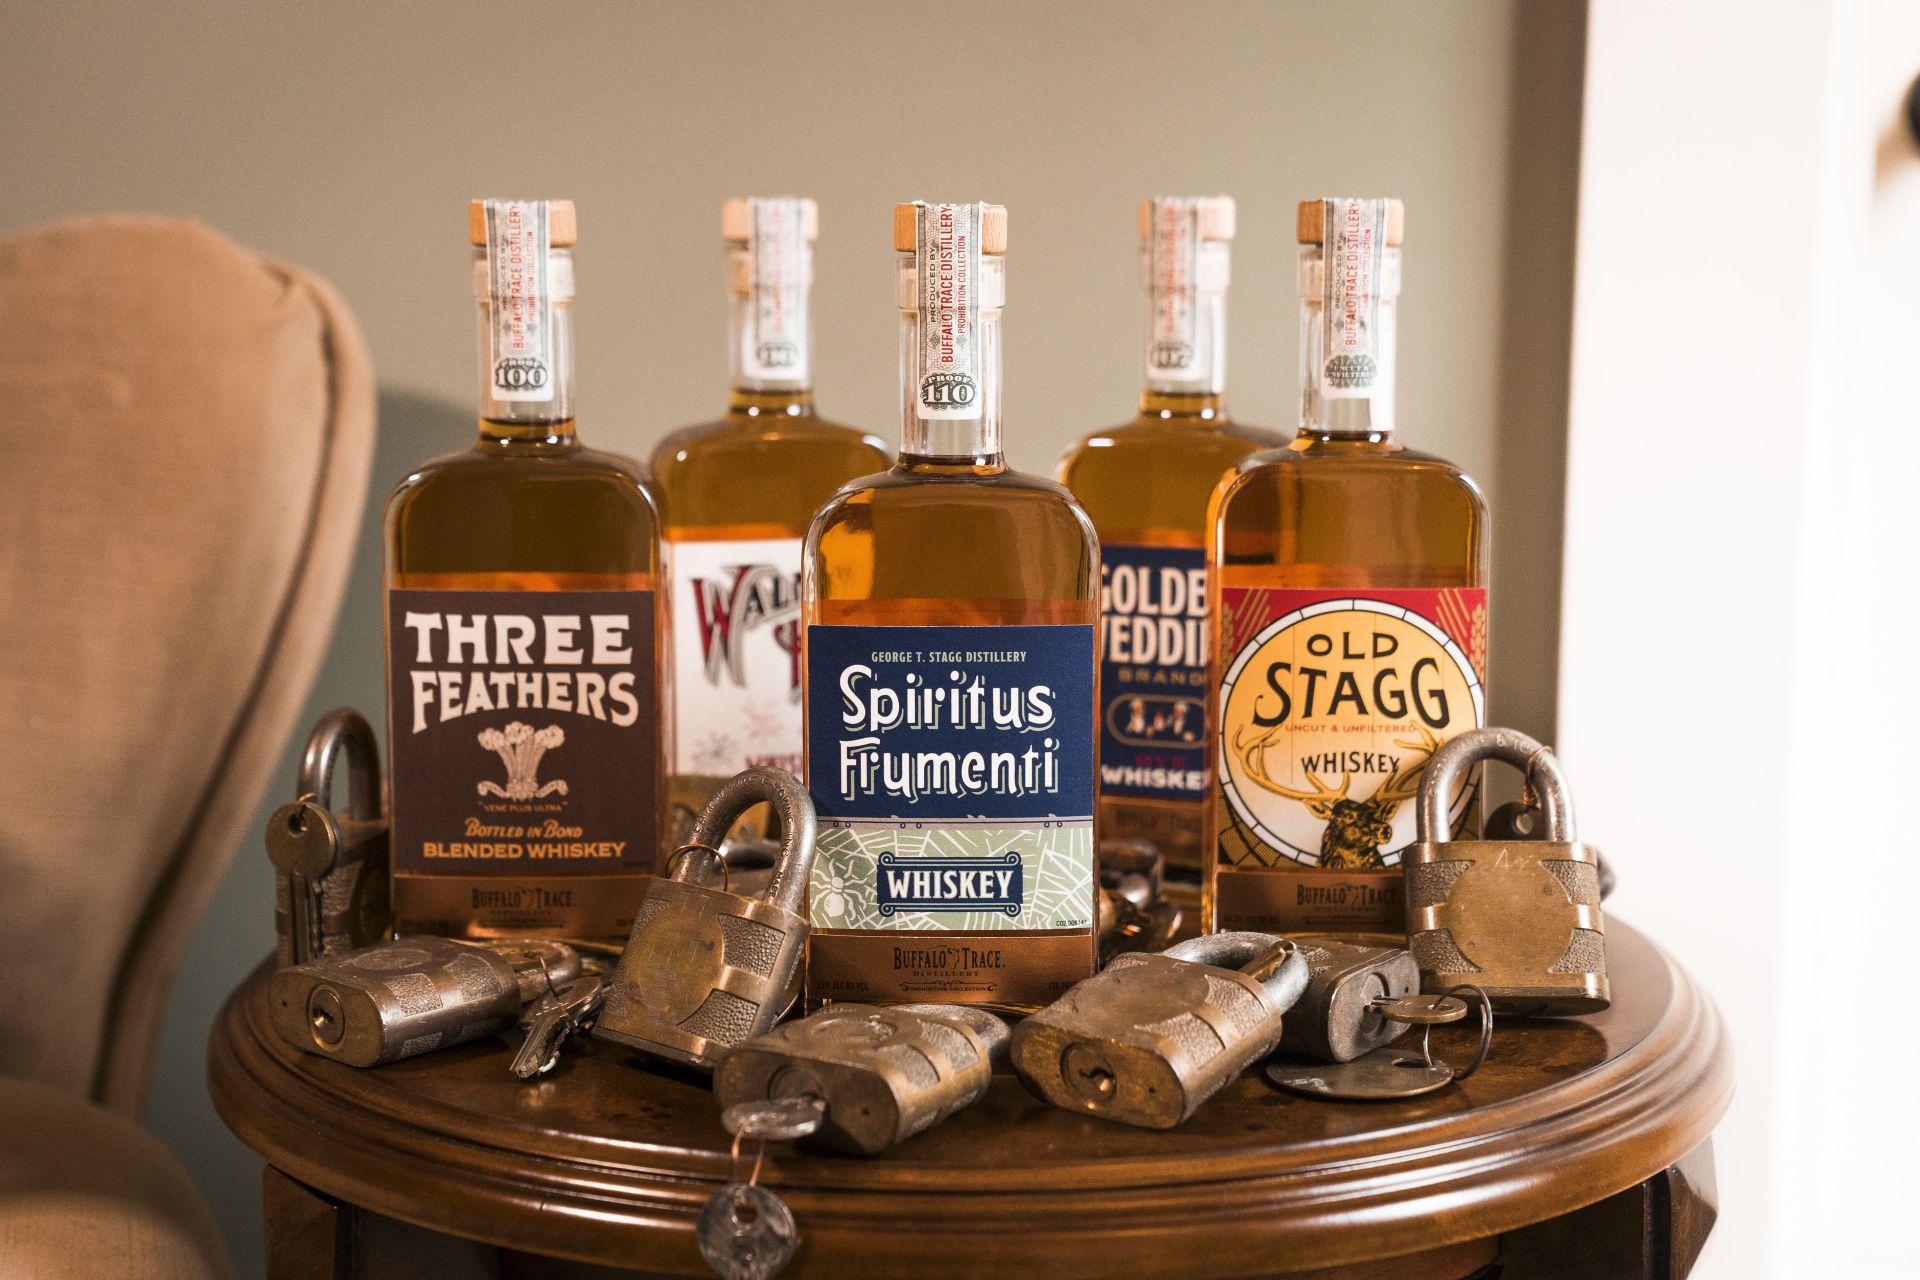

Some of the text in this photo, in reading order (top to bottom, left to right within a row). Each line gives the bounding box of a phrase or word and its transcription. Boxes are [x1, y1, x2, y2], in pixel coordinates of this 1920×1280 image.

[929, 247, 936, 261] BY
[1336, 239, 1343, 252] BY
[509, 205, 524, 349] BUFFALO TRACE DISTILLERY
[940, 206, 954, 363] BUFFALO TRACE DISTILLERY
[957, 236, 966, 334] PROHIBITION COLLECTION
[1345, 202, 1360, 346] BUFFALO TRACE DISTILLERY
[497, 366, 548, 386] 100
[928, 375, 972, 385] PROOF
[923, 384, 974, 403] 110
[404, 611, 633, 665] THREE
[1306, 631, 1399, 660] OLD
[871, 651, 1027, 663] GEORGE T. STAGG DISTILLERY
[410, 671, 639, 734] FEATHERS
[839, 664, 1057, 733] Spiritus
[1252, 657, 1450, 729] STAGG
[1285, 724, 1417, 734] UNCUT & UNFILTERED
[839, 736, 1060, 804] Frumenti
[1300, 751, 1401, 775] WHISKEY
[423, 842, 626, 858] BLENDED WHISKEY
[886, 870, 1014, 899] WHISKEY
[1297, 884, 1346, 905] BUFFALO
[471, 887, 522, 909] BUFFALO
[893, 947, 947, 970] BUFFALO
